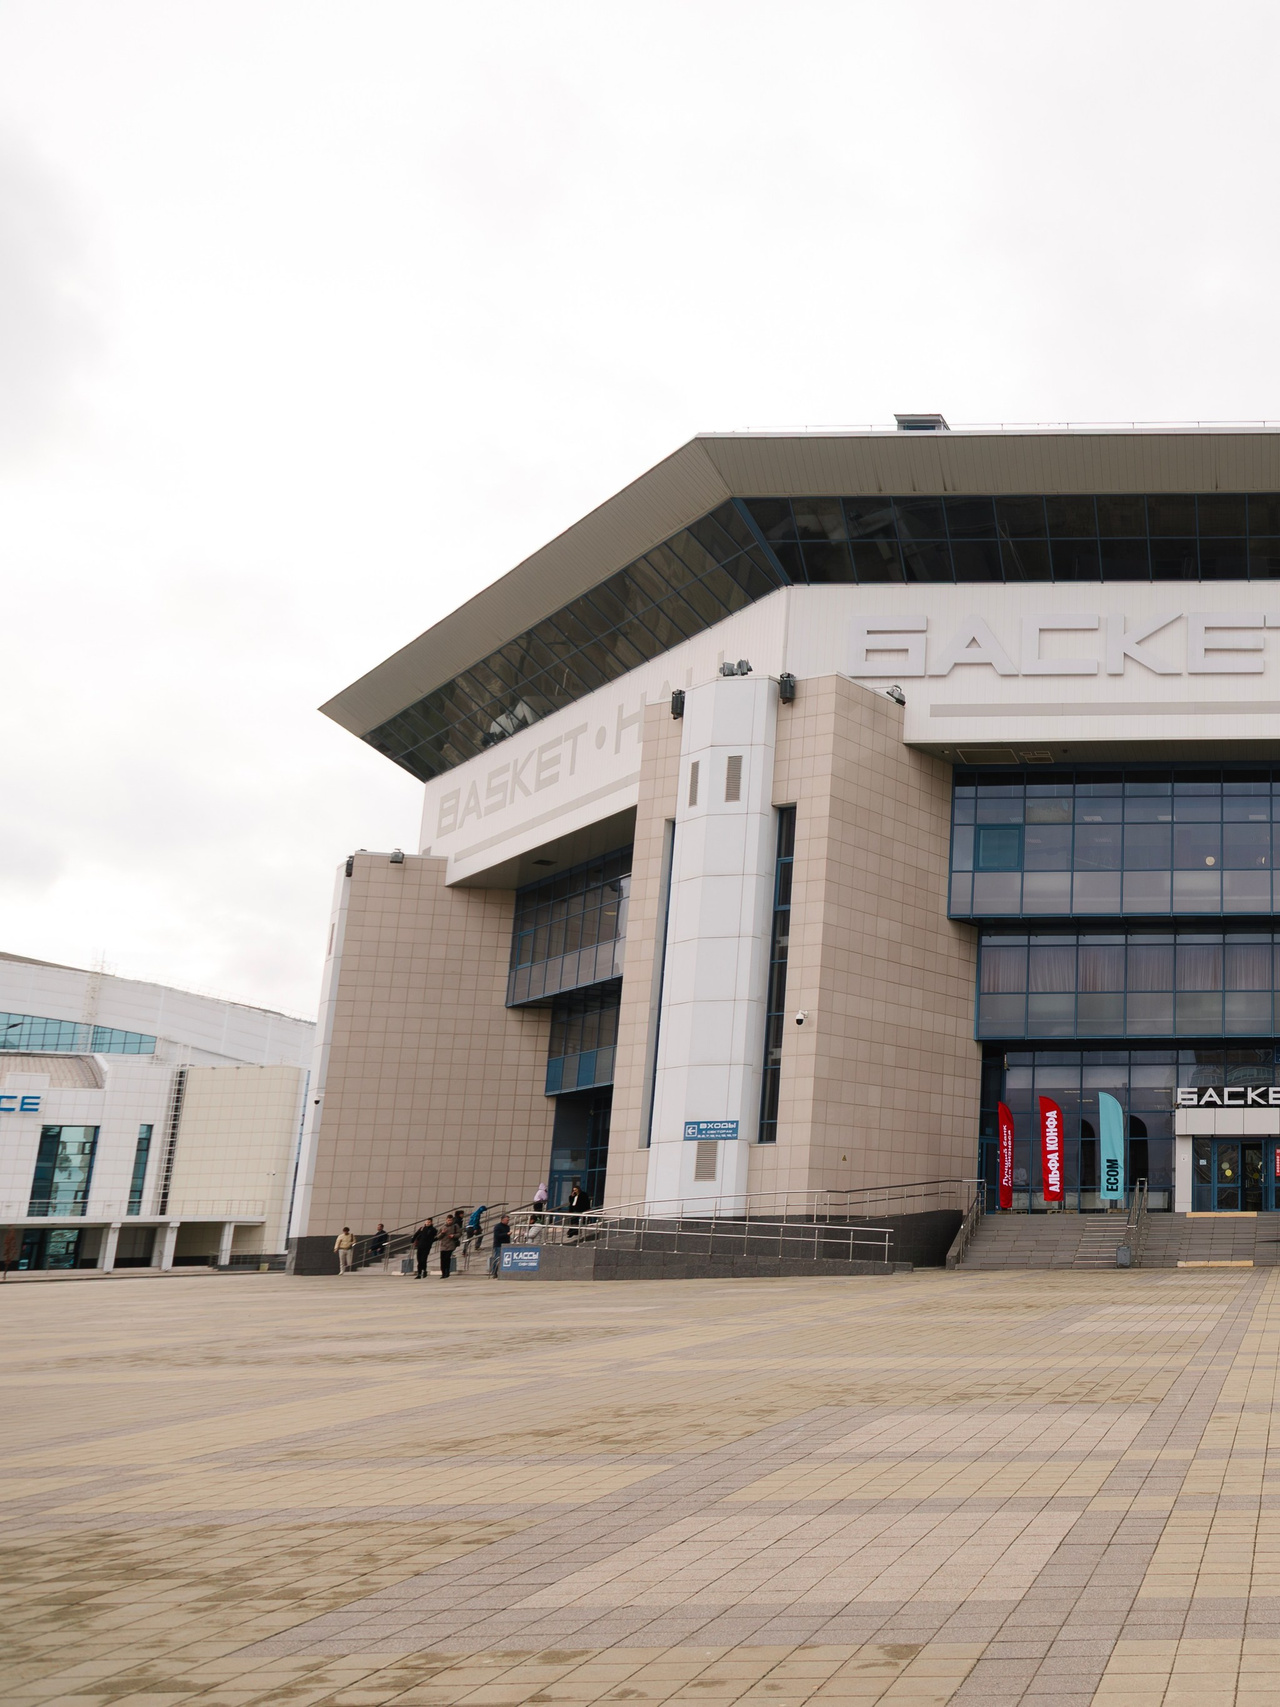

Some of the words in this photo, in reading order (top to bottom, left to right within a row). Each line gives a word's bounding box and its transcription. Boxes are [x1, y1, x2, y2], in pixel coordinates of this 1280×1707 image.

[436, 722, 588, 839] BASKET
[1045, 1110, 1059, 1151] КОНФА
[1046, 1152, 1060, 1193] АЛЬФА
[1106, 1158, 1119, 1192] ECOM
[512, 1251, 539, 1260] КАССЫ
